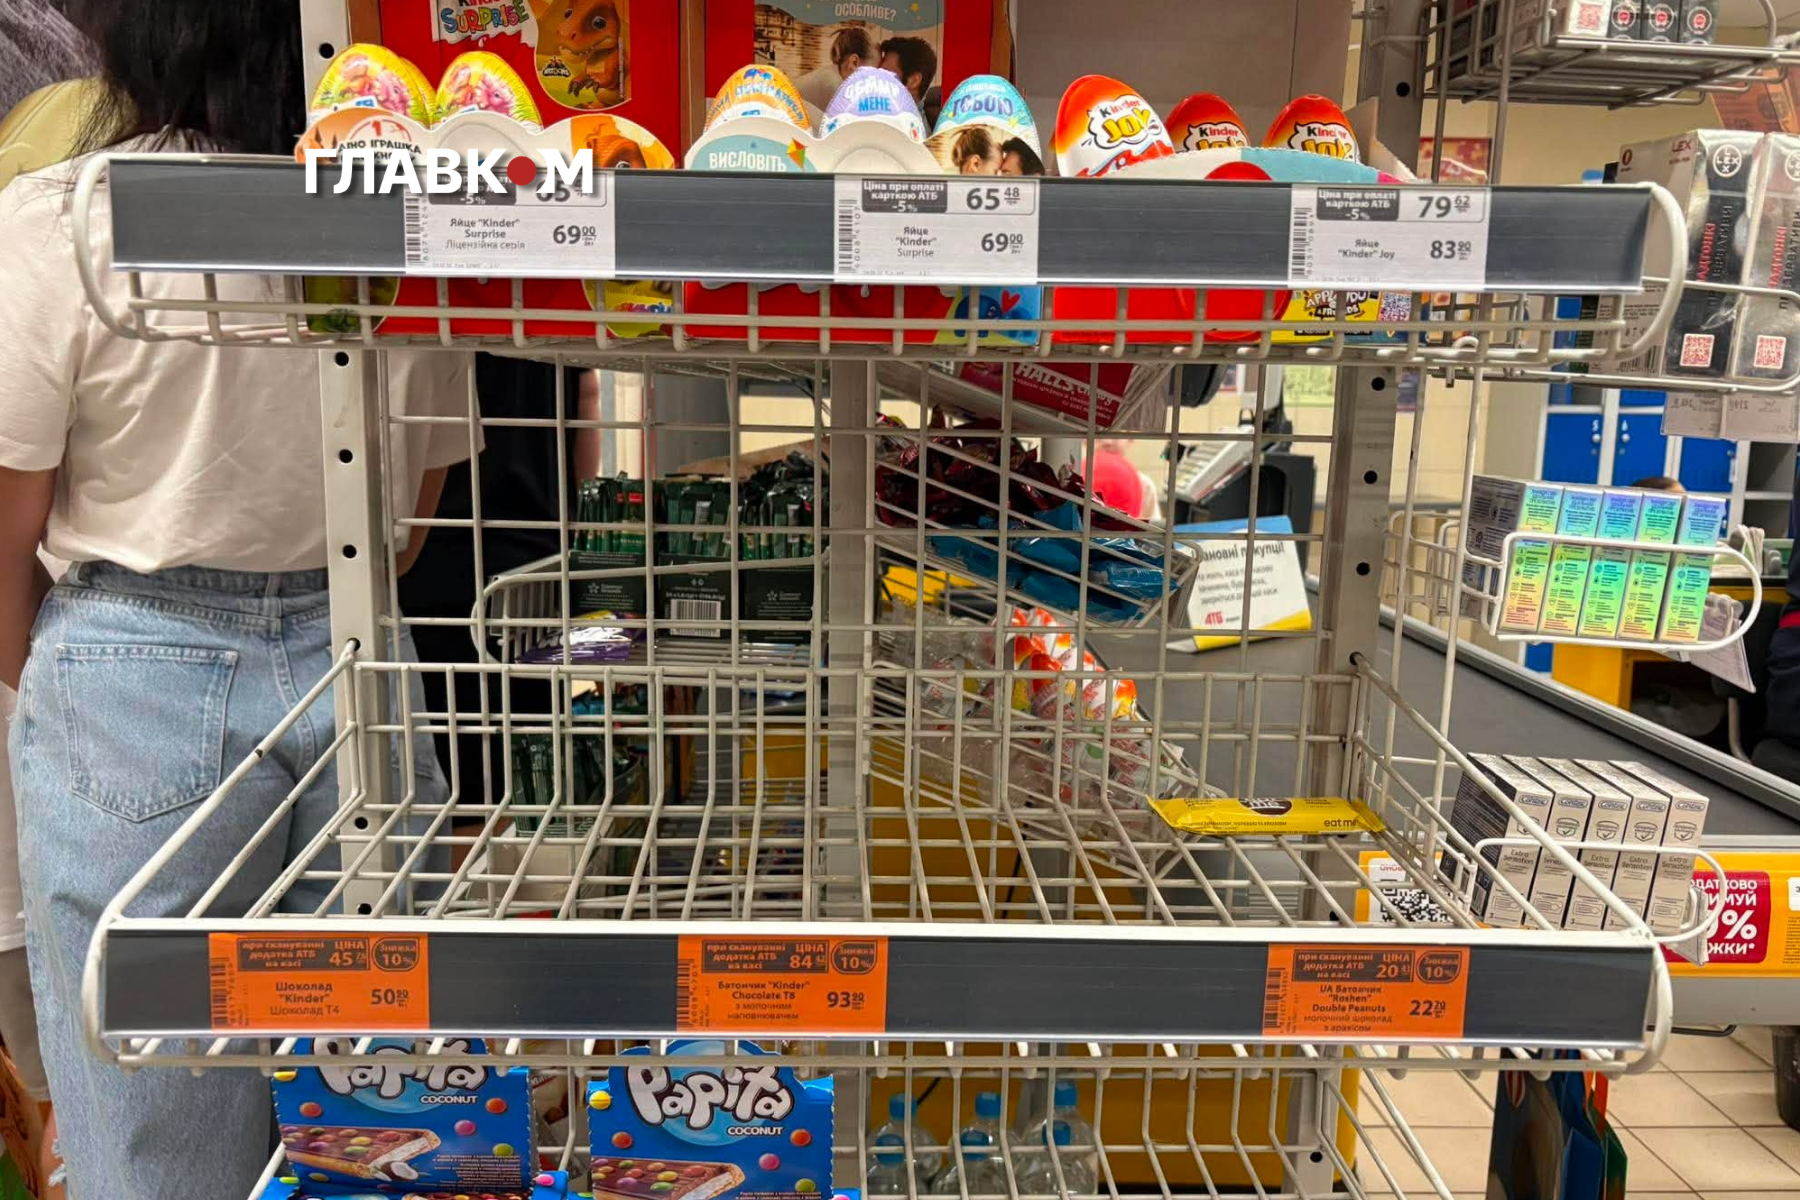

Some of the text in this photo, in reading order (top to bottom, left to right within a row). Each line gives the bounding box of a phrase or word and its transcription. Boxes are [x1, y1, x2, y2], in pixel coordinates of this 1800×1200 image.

[441, 0, 529, 34] SURPRISE
[835, 3, 897, 21] ОСОБЛИВЕ?
[858, 97, 892, 112] МЕНЕ
[1199, 126, 1239, 137] Kinder
[1672, 140, 1692, 152] LEX
[709, 151, 787, 172] ВИСЛОВІТЬ
[864, 181, 944, 193] Ціна при оплаті
[871, 192, 938, 201] карткою АТБ
[966, 187, 1020, 210] 65 48
[1318, 190, 1342, 200] Ціна
[1344, 192, 1363, 200] при
[1326, 200, 1370, 209] карткою
[1418, 196, 1452, 218] 79
[450, 219, 476, 230] Яйце
[465, 230, 506, 240] Surprise
[553, 225, 581, 245] 69
[904, 227, 929, 237] Яйце
[445, 240, 525, 251] Ліцензійна серія
[981, 232, 1009, 252] 69
[1355, 240, 1380, 249] Яйце
[897, 248, 934, 258] Surprise
[1430, 240, 1457, 259] 83
[1380, 250, 1395, 260] Joy
[1324, 818, 1341, 828] eat
[1511, 850, 1529, 858] Extra
[1591, 854, 1610, 862] Extra
[1503, 855, 1534, 865] Sensation
[1584, 860, 1614, 869] Sensation
[1630, 856, 1648, 864] Extra
[1669, 856, 1688, 864] Extra
[1622, 862, 1653, 870] Sensation
[1662, 861, 1691, 870] Sensation
[334, 941, 365, 951] ЦІНА
[796, 944, 824, 955] ЦІНА
[296, 950, 316, 958] АТБ
[329, 952, 354, 966] 45
[757, 952, 777, 961] АТБ
[1383, 954, 1410, 963] ЦІНА
[790, 954, 812, 969] 84
[1376, 964, 1399, 978] 20
[276, 982, 333, 993] Шоколад
[718, 981, 766, 990] Батончик
[1335, 986, 1382, 994] Батончик
[372, 988, 396, 1005] 50
[732, 991, 781, 1000] Chocolate
[826, 991, 851, 1008] 93
[1329, 994, 1372, 1003] "Roshen"
[270, 1006, 323, 1016] Шоколад
[1312, 1004, 1386, 1013] Double Peanuts
[1410, 999, 1433, 1016] 22
[1304, 1014, 1393, 1024] молочний шоколад
[1330, 1024, 1372, 1033] арахісом
[420, 1095, 478, 1105] COCONUT
[625, 1066, 795, 1129] Papita
[727, 1126, 783, 1136] COCONUT
